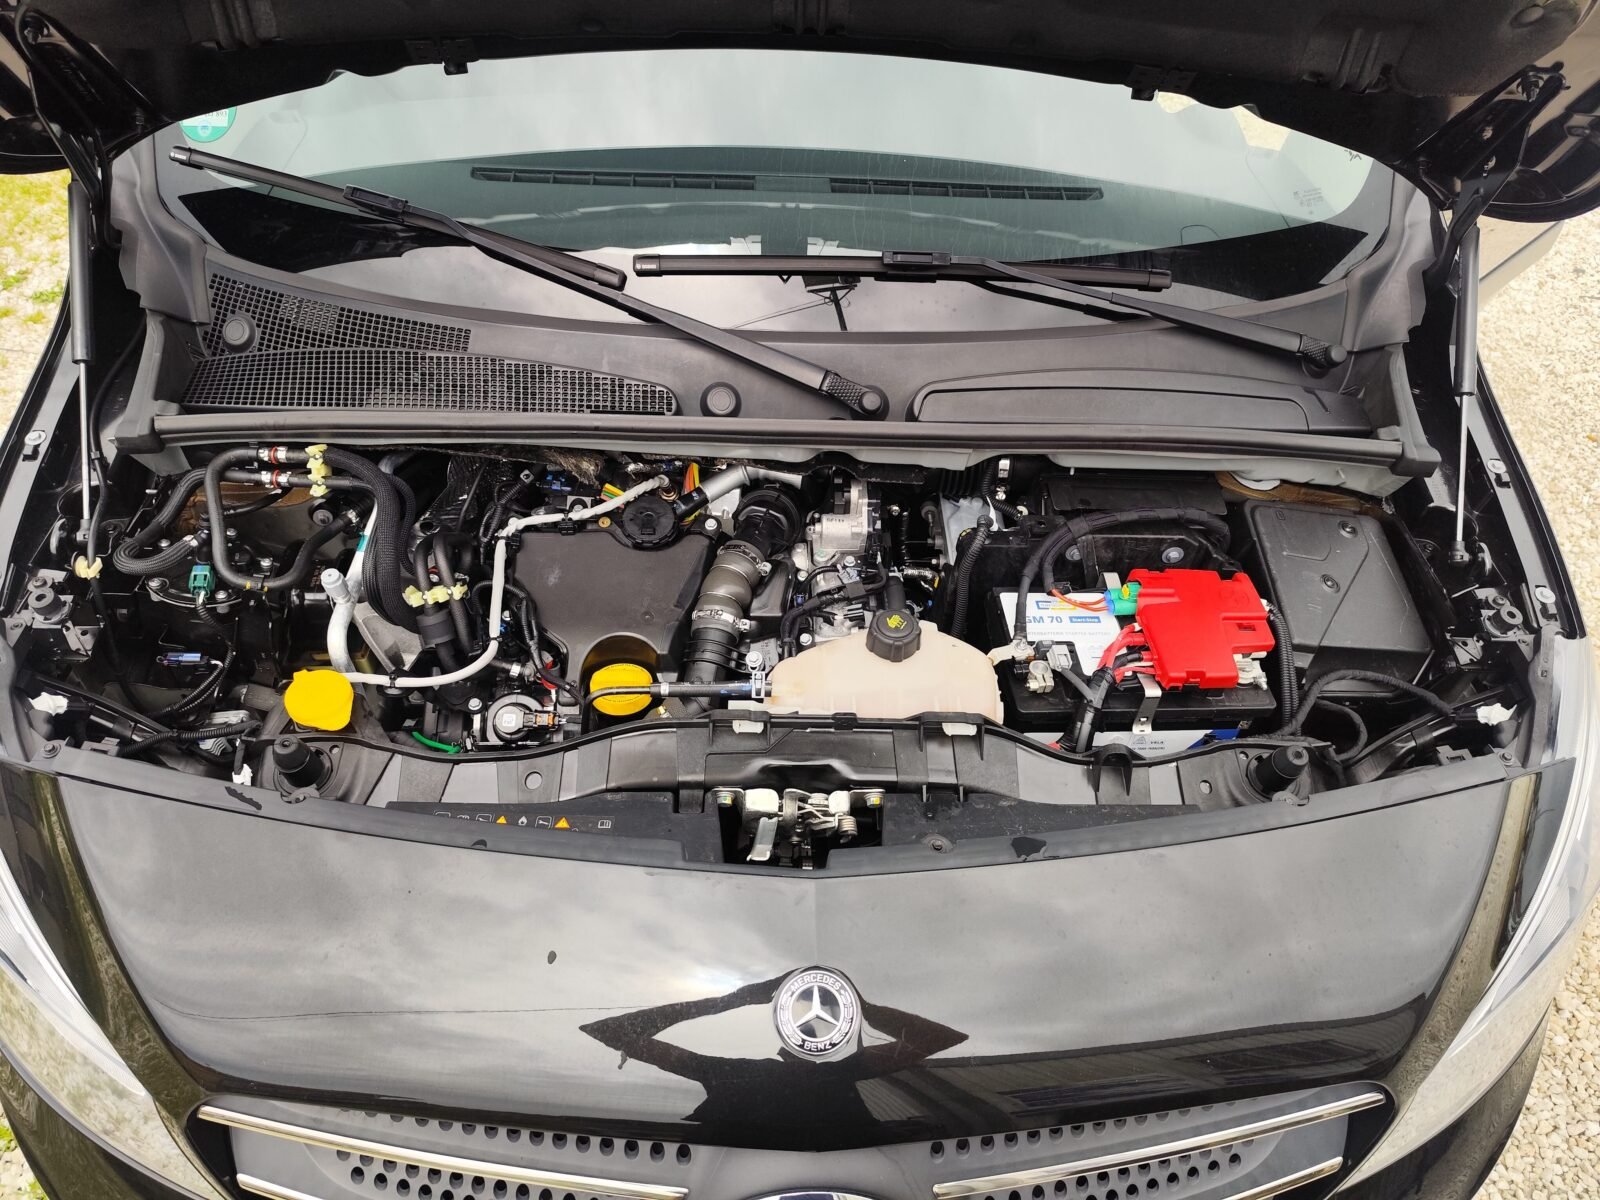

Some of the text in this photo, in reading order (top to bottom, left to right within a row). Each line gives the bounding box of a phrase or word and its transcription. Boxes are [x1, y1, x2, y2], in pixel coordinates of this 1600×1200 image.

[1048, 616, 1062, 624] 70
[790, 974, 841, 992] MERCEDES
[804, 1040, 832, 1052] BENZ
